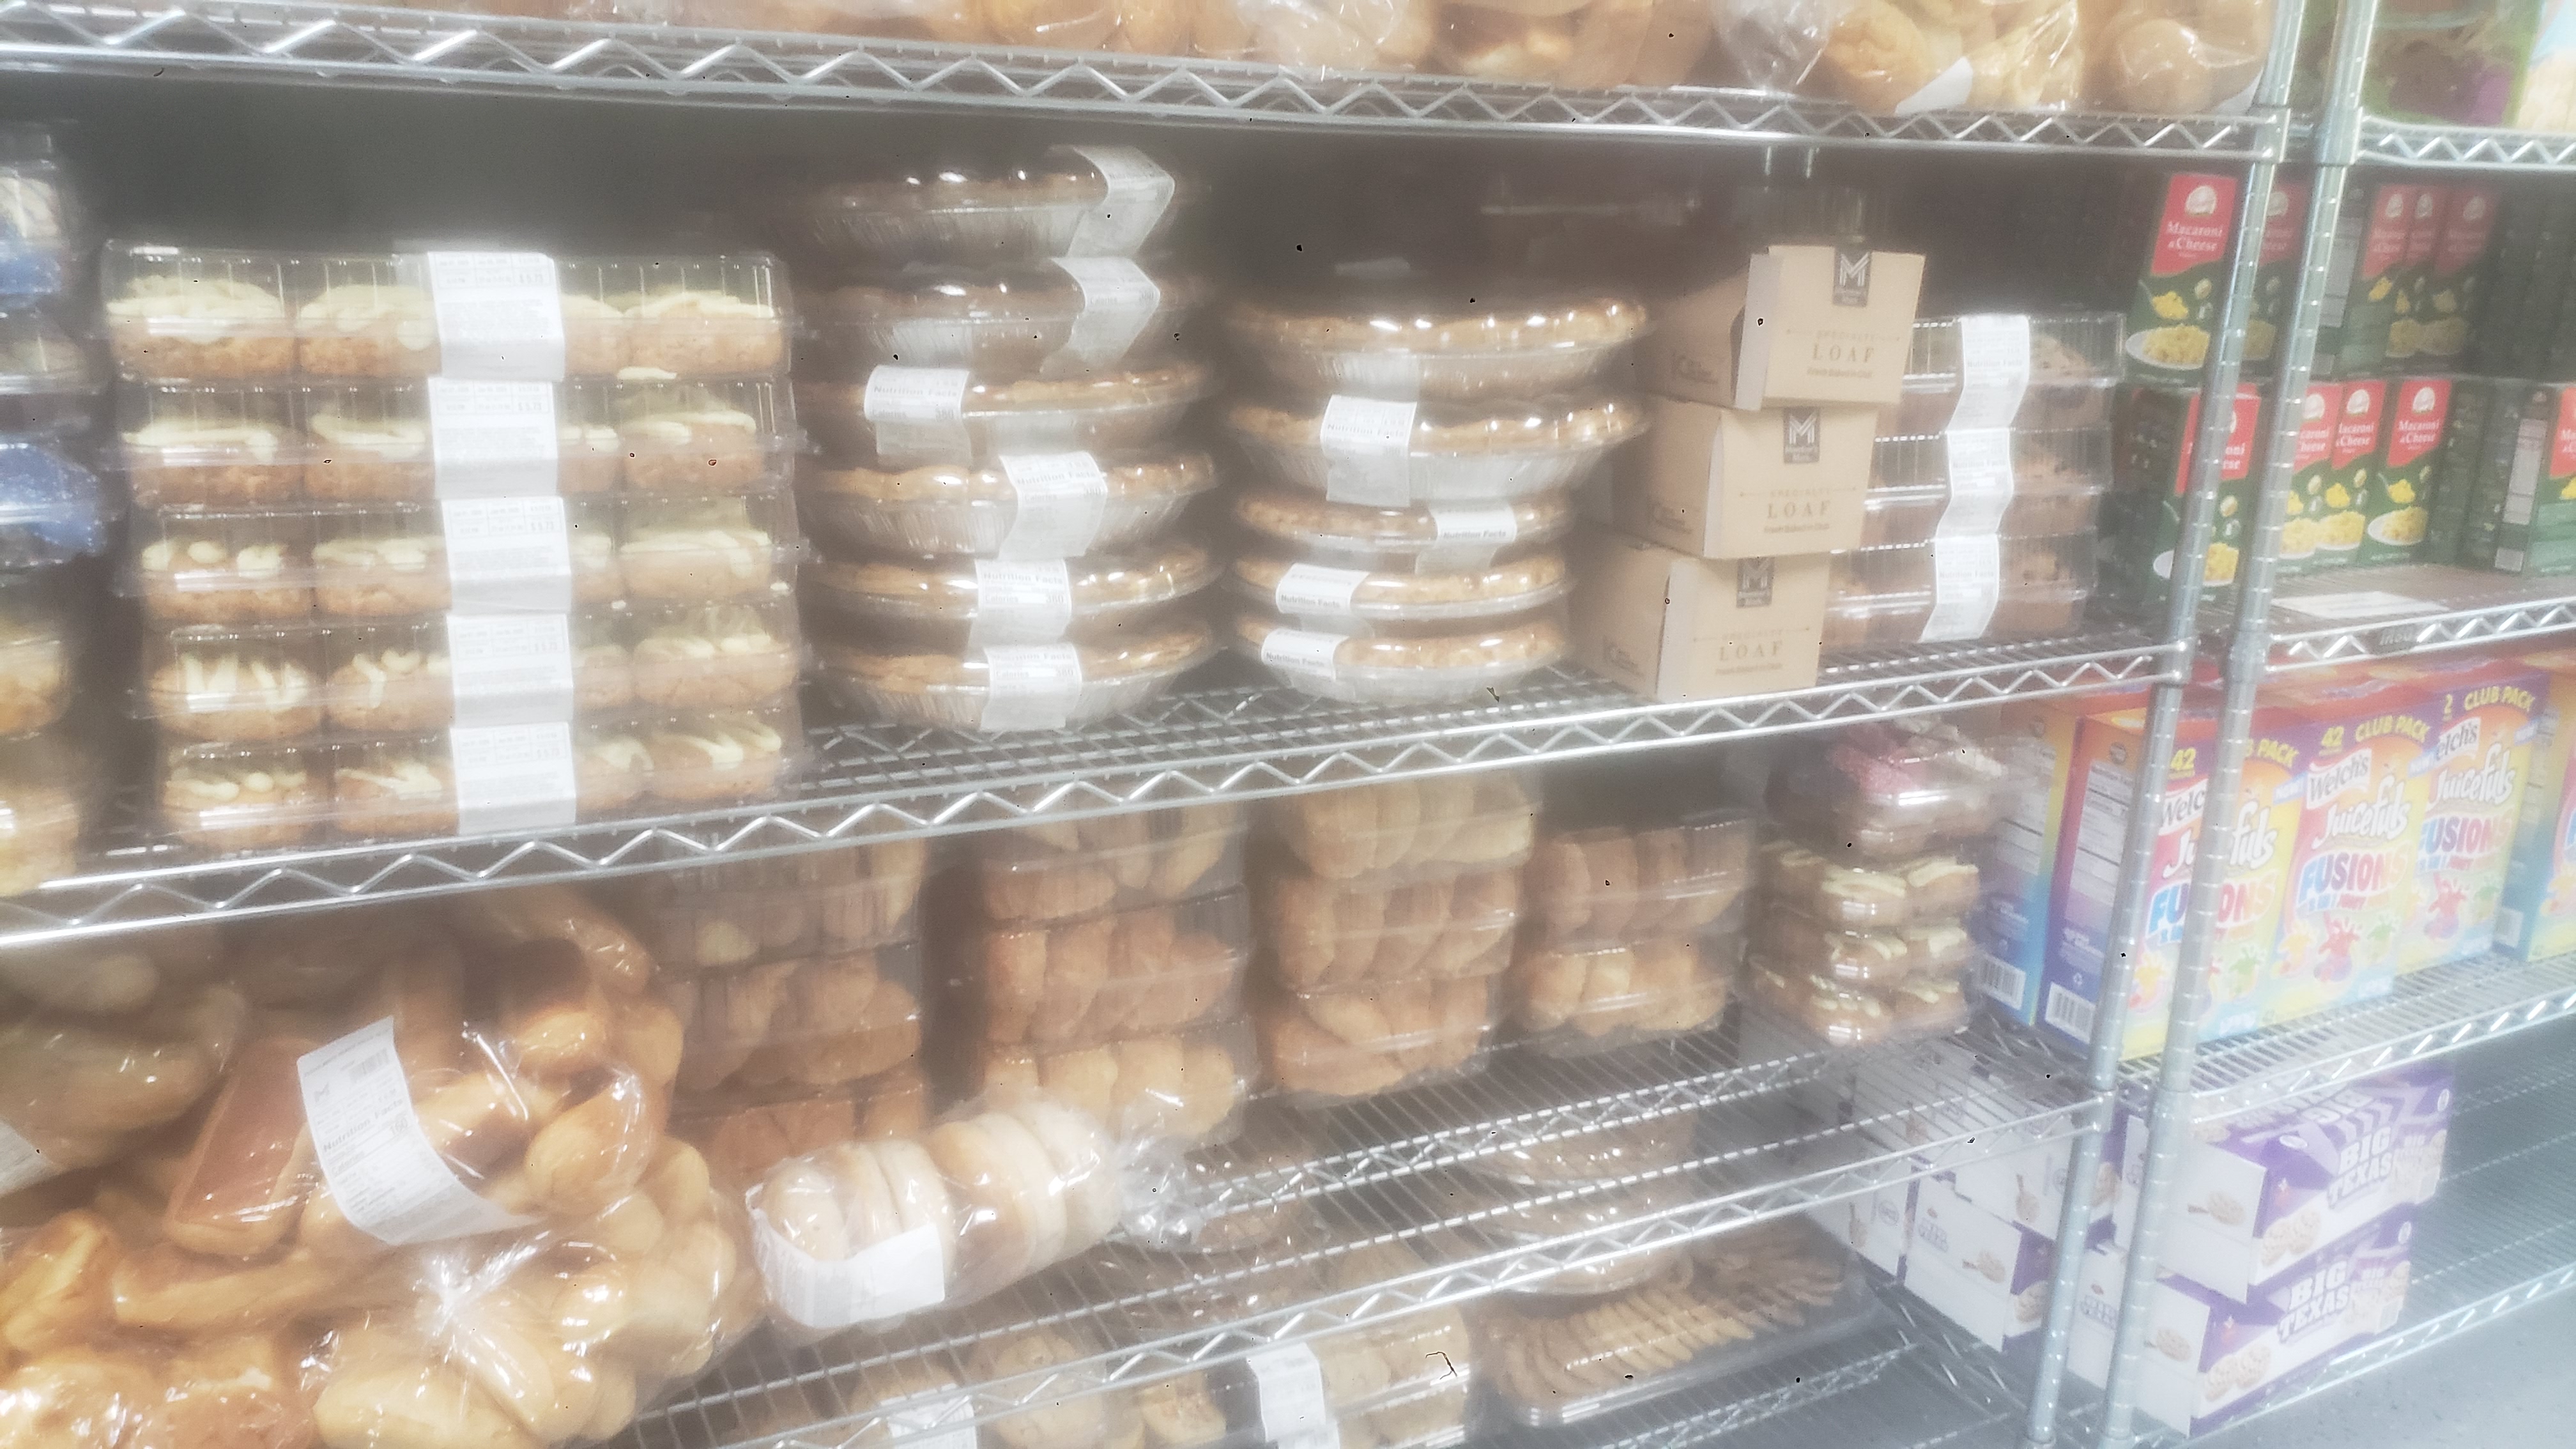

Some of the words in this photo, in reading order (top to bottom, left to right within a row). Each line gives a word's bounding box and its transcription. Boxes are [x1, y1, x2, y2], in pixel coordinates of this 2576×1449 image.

[2166, 221, 2223, 237] Macaroni
[1811, 342, 1875, 363] LOAF
[873, 385, 924, 395] Nutrition
[928, 388, 958, 397] Facts
[1327, 423, 1373, 434] Nutrition
[1377, 429, 1405, 438] Facts
[2301, 429, 2330, 439] caroni
[2398, 418, 2441, 431] Macaroni
[2300, 441, 2327, 452] heese
[1016, 474, 1065, 485] Nutrition
[1068, 470, 1097, 479] Facts
[1024, 493, 1058, 503] Calories
[1767, 499, 1832, 519] LOAF
[983, 572, 1031, 582] Nutrition
[1035, 574, 1063, 585] Facts
[985, 594, 1019, 604] Calories
[1281, 594, 1315, 605] Nutrition
[1318, 599, 1341, 608] Facts
[1266, 652, 1300, 665] Nutrition
[1301, 658, 1325, 668] Facts
[1719, 640, 1783, 661] LOAF
[995, 670, 1029, 680] Calories
[2443, 694, 2453, 714] 2
[2464, 686, 2501, 711] CLUB
[2501, 686, 2536, 712] PACK
[2321, 726, 2345, 747] 42
[2355, 715, 2393, 742] CLUB
[2395, 715, 2432, 744] PACK
[2435, 723, 2478, 761] elch's
[2170, 747, 2196, 771] 42
[2257, 739, 2299, 768] PACK
[2309, 754, 2370, 803] Welch's
[2425, 742, 2516, 811] Juicefuls
[2311, 775, 2412, 850] Juicefuls
[2298, 842, 2412, 908] FUSIONS
[323, 1118, 371, 1153] Nutrition
[374, 1099, 404, 1120] Facts
[2337, 1126, 2391, 1177] BIG
[332, 1151, 365, 1177] Calories
[2327, 1151, 2393, 1209] TEXAS
[2288, 1260, 2348, 1312] BIG
[2278, 1285, 2350, 1344] TEXAS
